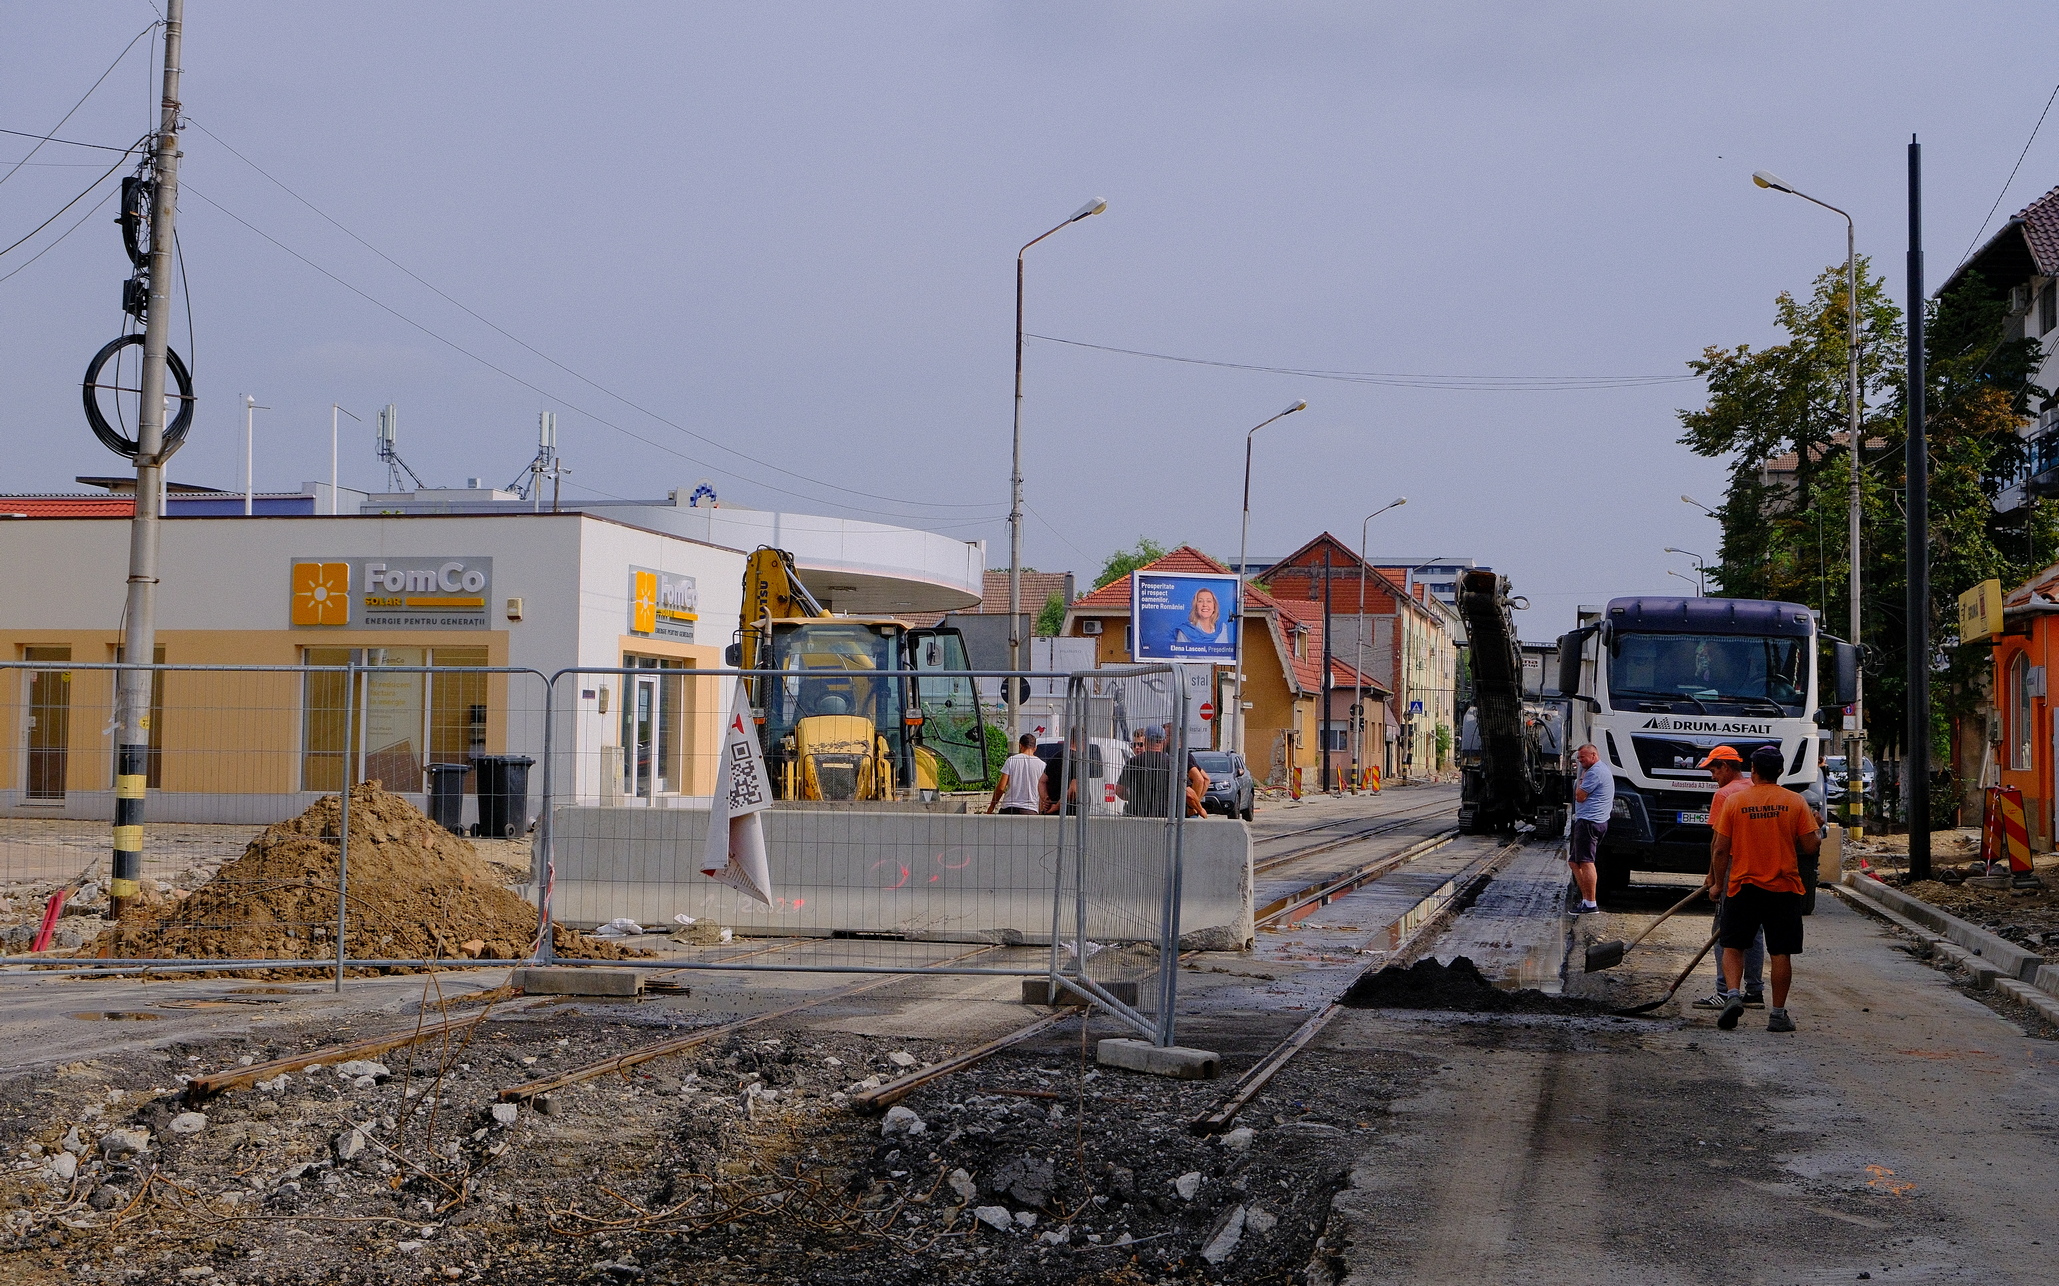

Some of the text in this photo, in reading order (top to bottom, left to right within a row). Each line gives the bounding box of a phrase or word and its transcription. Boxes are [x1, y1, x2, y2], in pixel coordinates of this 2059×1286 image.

[364, 562, 486, 593] FomCo
[1141, 582, 1175, 590] Prosperitate
[661, 575, 699, 609] FomCo
[364, 597, 402, 606] SOLAR
[365, 617, 401, 625] ENERGIE
[1185, 645, 1207, 653] Lasconi,
[1191, 674, 1209, 686] stal
[1673, 720, 1773, 735] DRUM-ASFALT
[1741, 805, 1789, 814] DRUMURI
[1749, 811, 1780, 820] BIHOR
